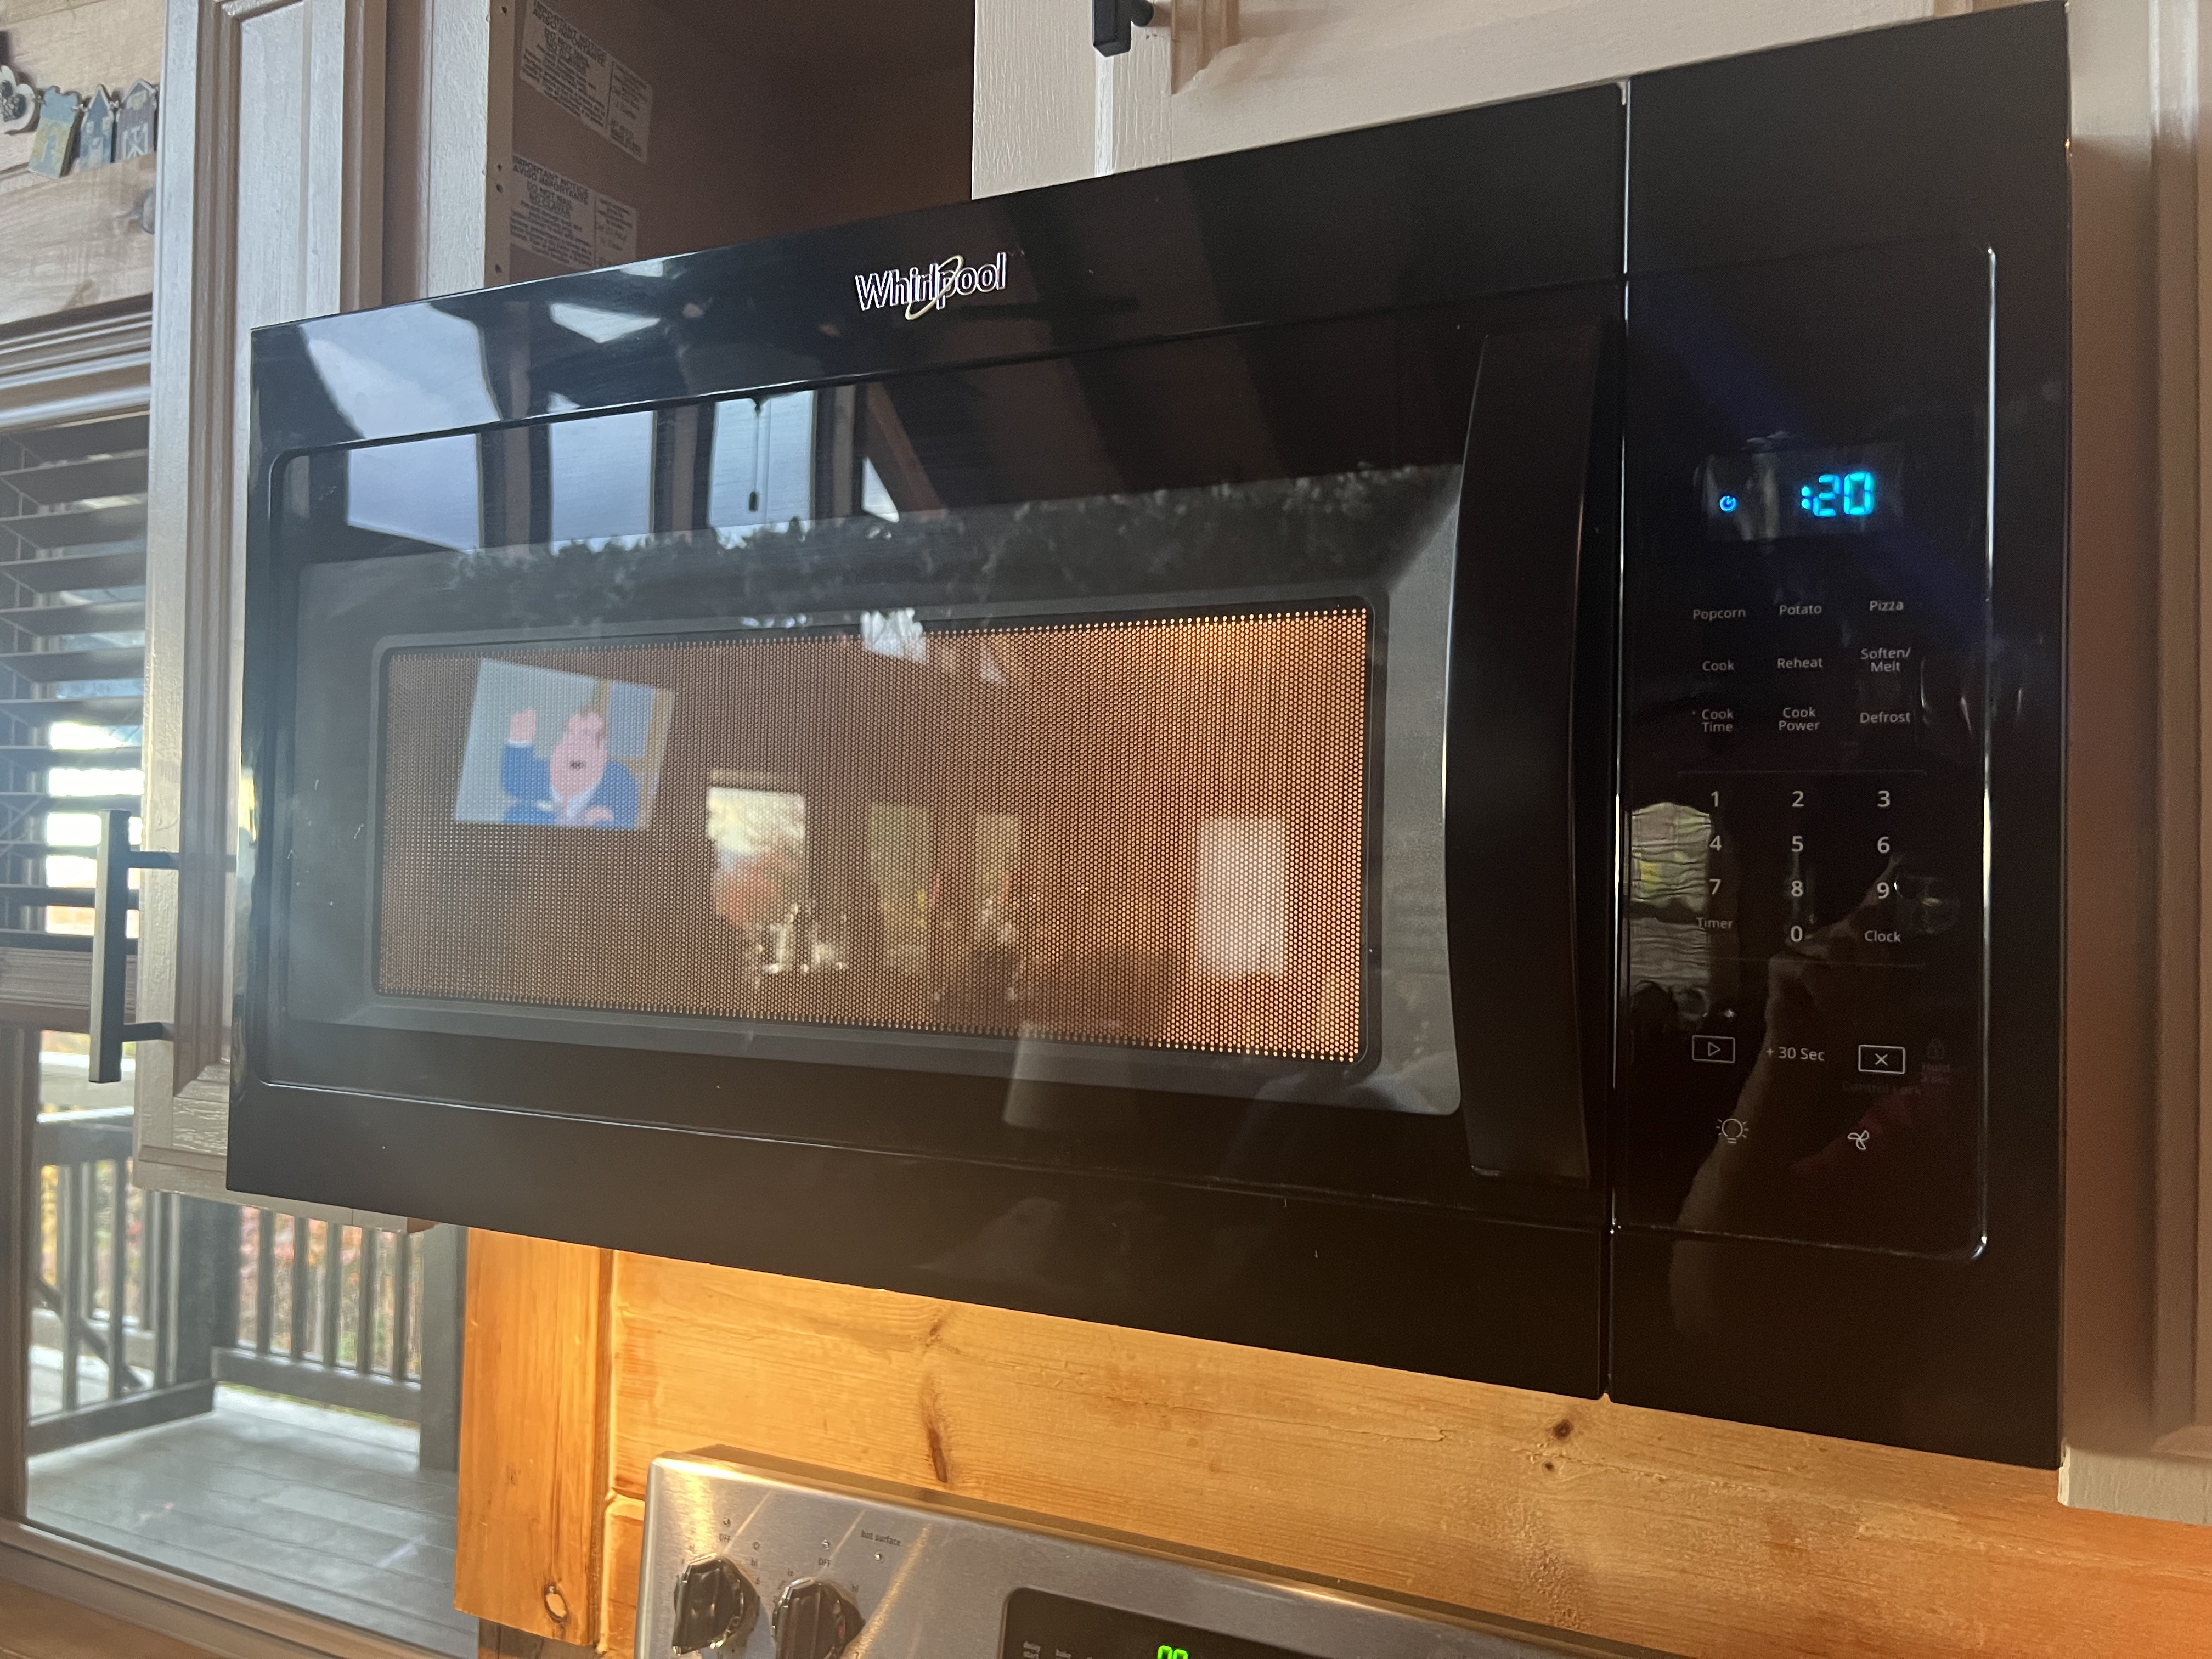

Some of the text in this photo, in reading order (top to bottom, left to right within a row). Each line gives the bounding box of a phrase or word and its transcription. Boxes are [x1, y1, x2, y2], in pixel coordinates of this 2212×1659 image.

[854, 251, 1007, 311] Whirlpool
[1779, 604, 1822, 616] Potato
[1869, 600, 1904, 612] Pizza
[1692, 608, 1747, 622] Popcorn
[1860, 647, 1911, 660] Soften/
[1702, 659, 1735, 672] Cook
[1777, 657, 1823, 669] Reheat
[1870, 661, 1900, 673] Melt
[1701, 708, 1734, 720] Cook
[1782, 706, 1816, 718] Cook
[1859, 711, 1911, 724] Defrost
[1701, 721, 1733, 733] Time
[1778, 720, 1820, 731] Power
[1711, 791, 1719, 807] 1
[1791, 791, 1804, 808] 2
[1877, 790, 1891, 808] 3
[1709, 836, 1722, 851] 4
[1791, 836, 1804, 853] 5
[1877, 836, 1890, 854] 6
[1710, 878, 1722, 895] 7
[1790, 880, 1804, 897] 8
[1877, 882, 1890, 899] 9
[1697, 916, 1733, 929] Timer
[1790, 926, 1803, 943] 0
[1864, 930, 1901, 943] Clock
[1800, 1047, 1825, 1062] Sec
[860, 1530, 901, 1546] hot surface
[819, 1558, 832, 1567] OFF
